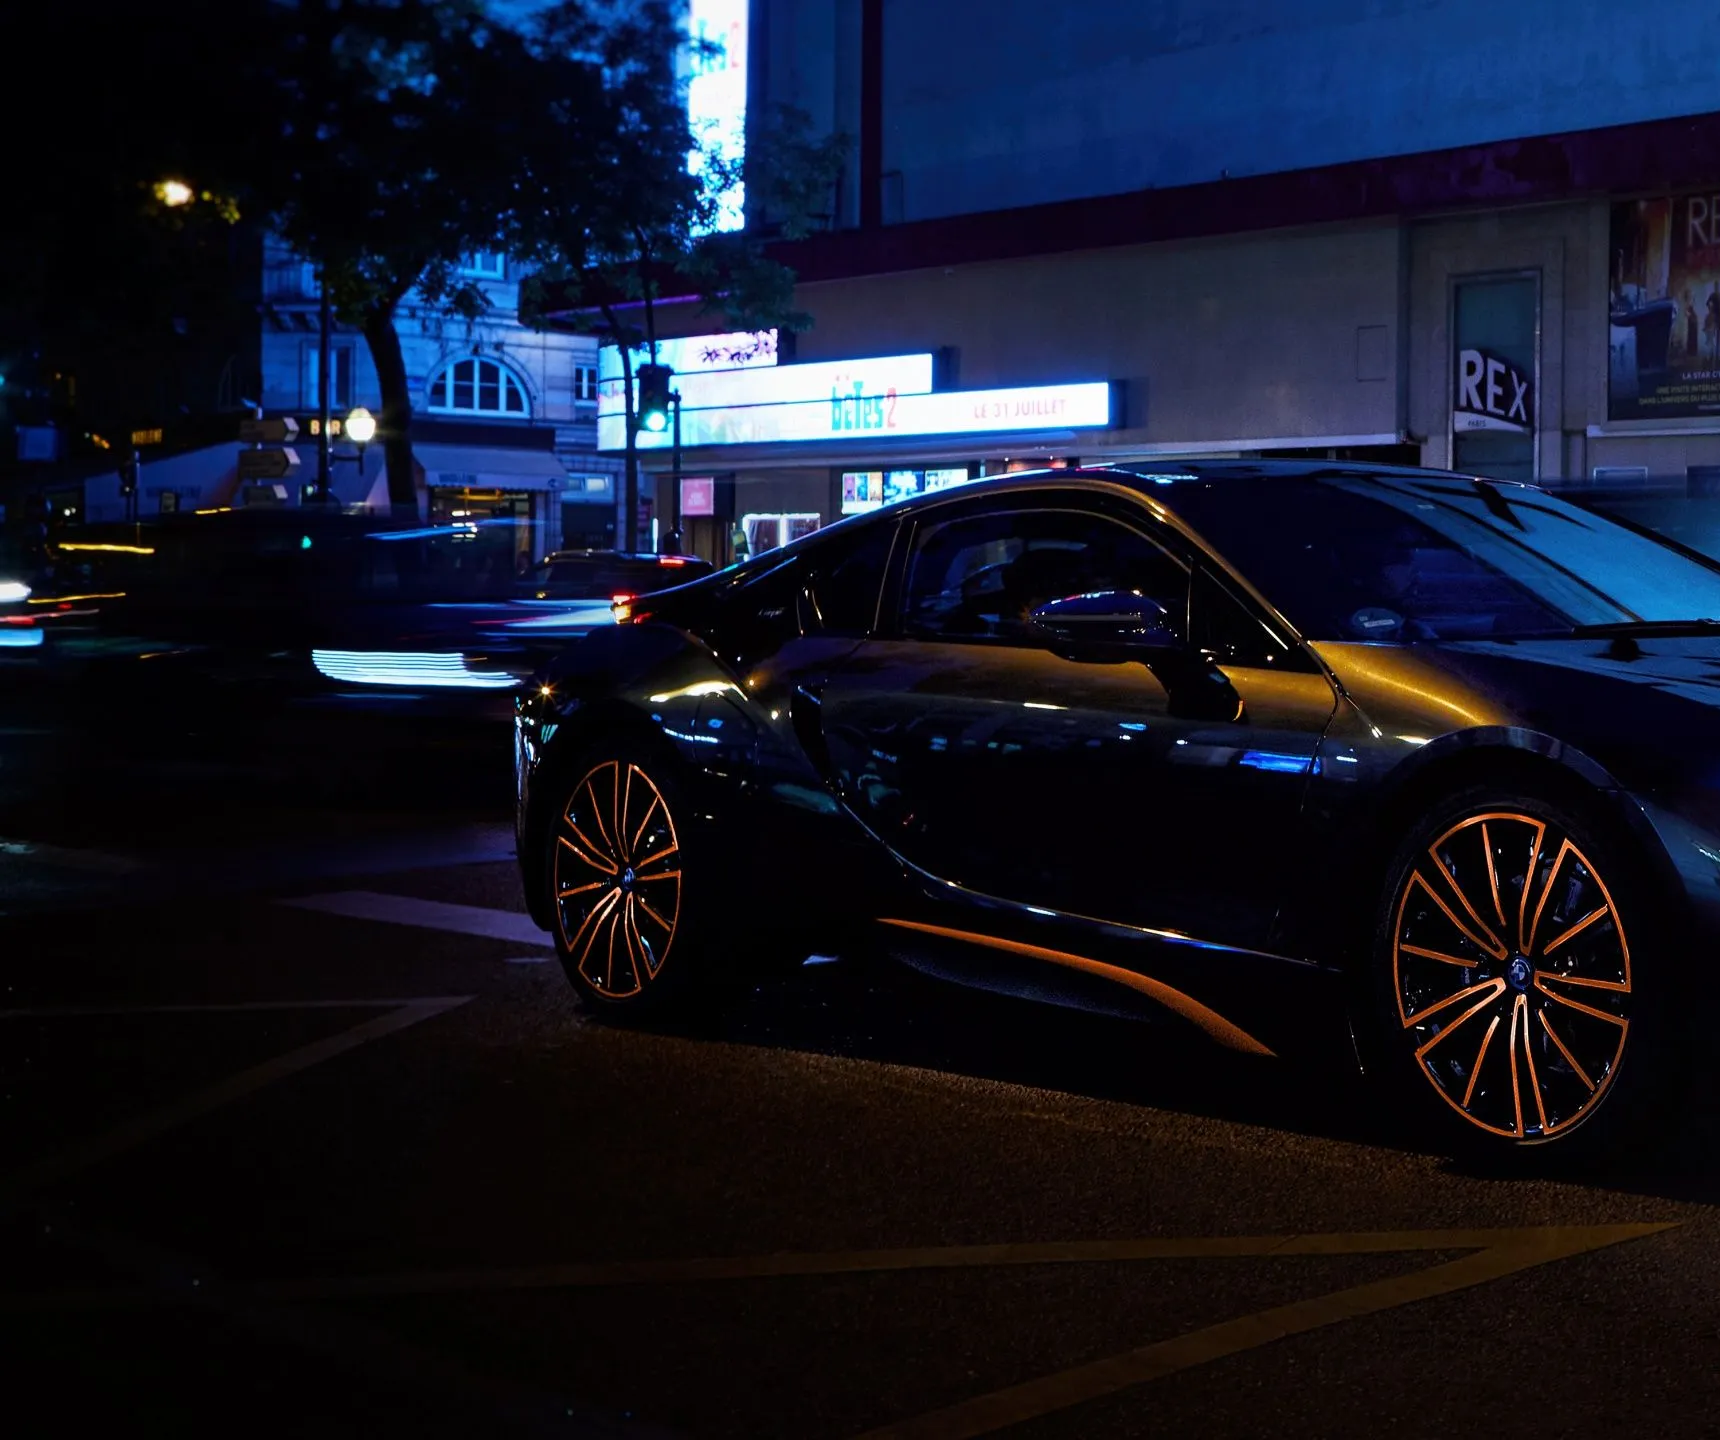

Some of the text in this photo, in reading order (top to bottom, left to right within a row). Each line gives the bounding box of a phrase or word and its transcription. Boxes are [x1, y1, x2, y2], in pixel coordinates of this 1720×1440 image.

[1460, 349, 1528, 423] REX
[1693, 371, 1710, 380] STAR
[887, 387, 897, 428] 2
[974, 397, 1066, 419] LE 31 JUILLET
[310, 418, 341, 436] BR
